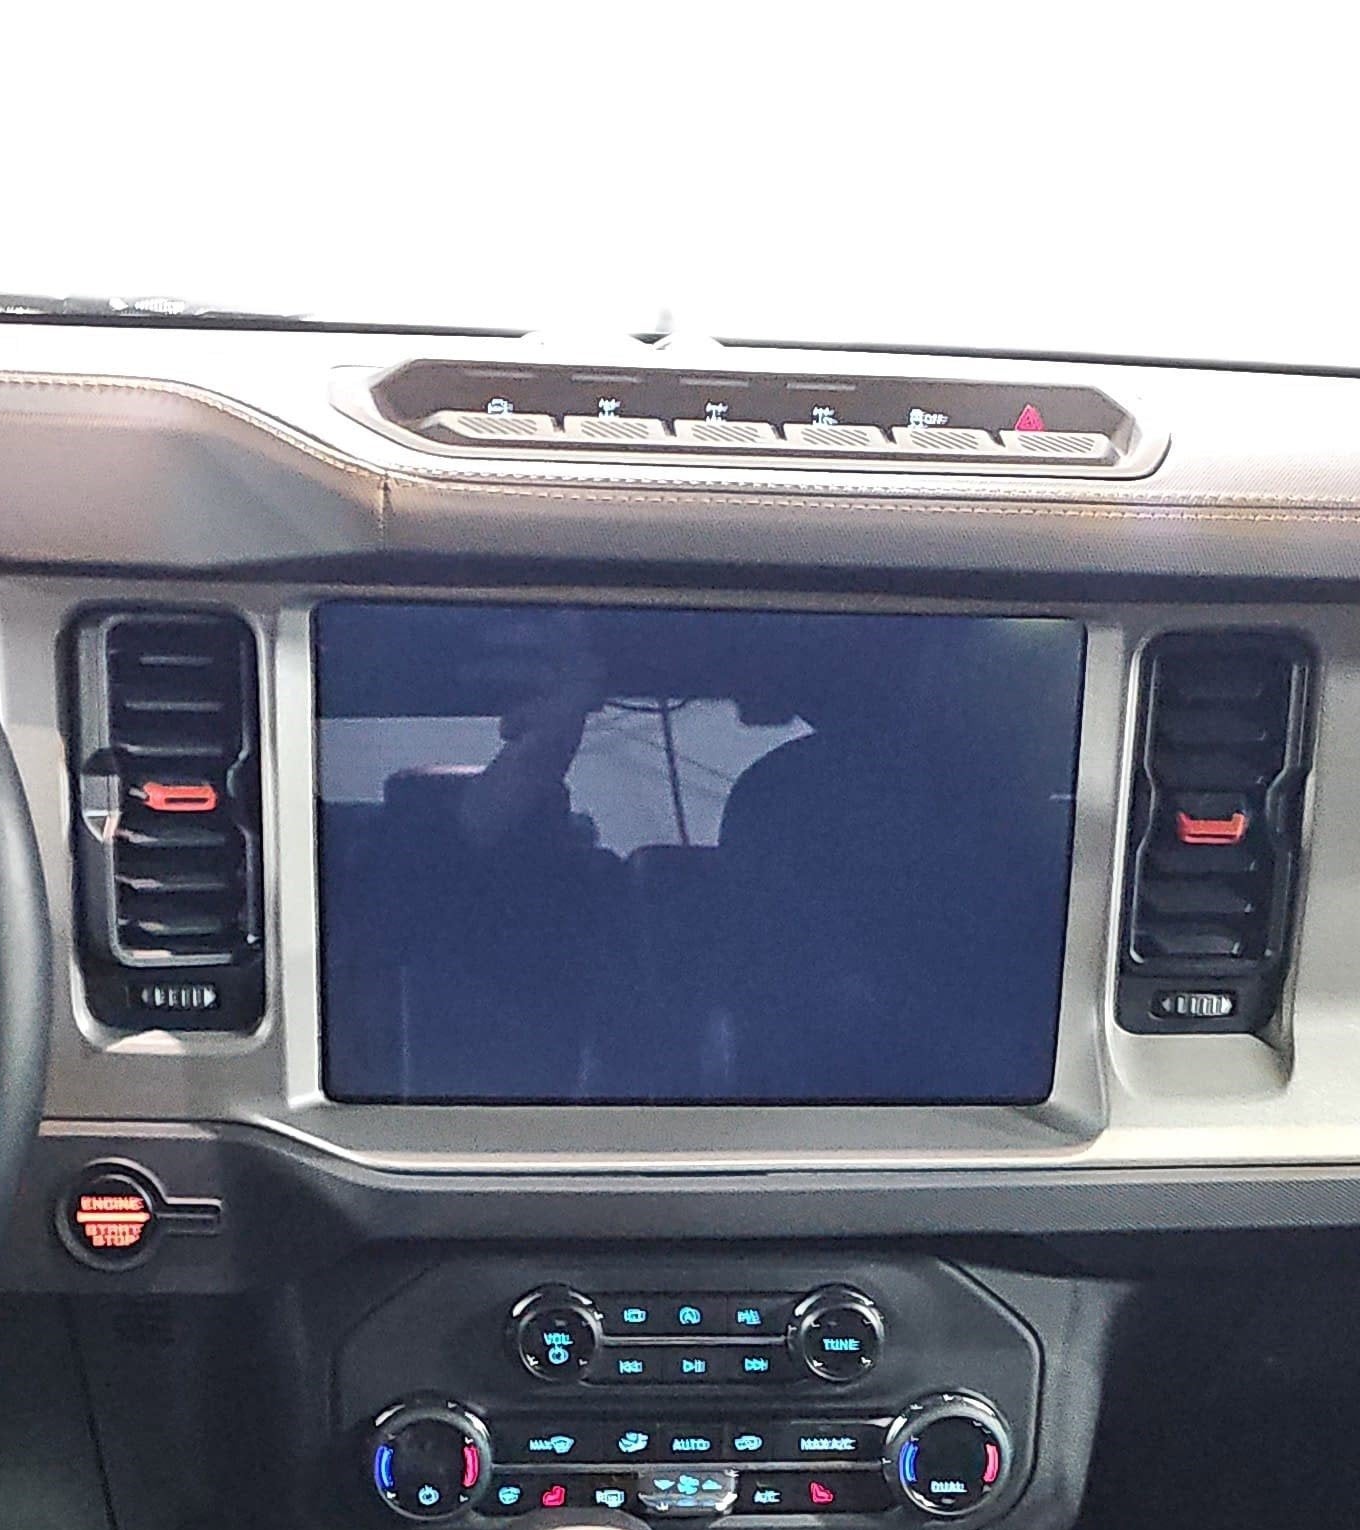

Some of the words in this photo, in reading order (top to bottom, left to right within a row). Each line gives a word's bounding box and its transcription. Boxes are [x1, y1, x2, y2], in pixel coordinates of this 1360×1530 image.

[81, 1197, 144, 1210] ENGINE
[86, 1224, 143, 1236] START
[93, 1236, 140, 1246] STOP
[822, 1338, 861, 1351] TUNE
[672, 1438, 711, 1451] AUTO
